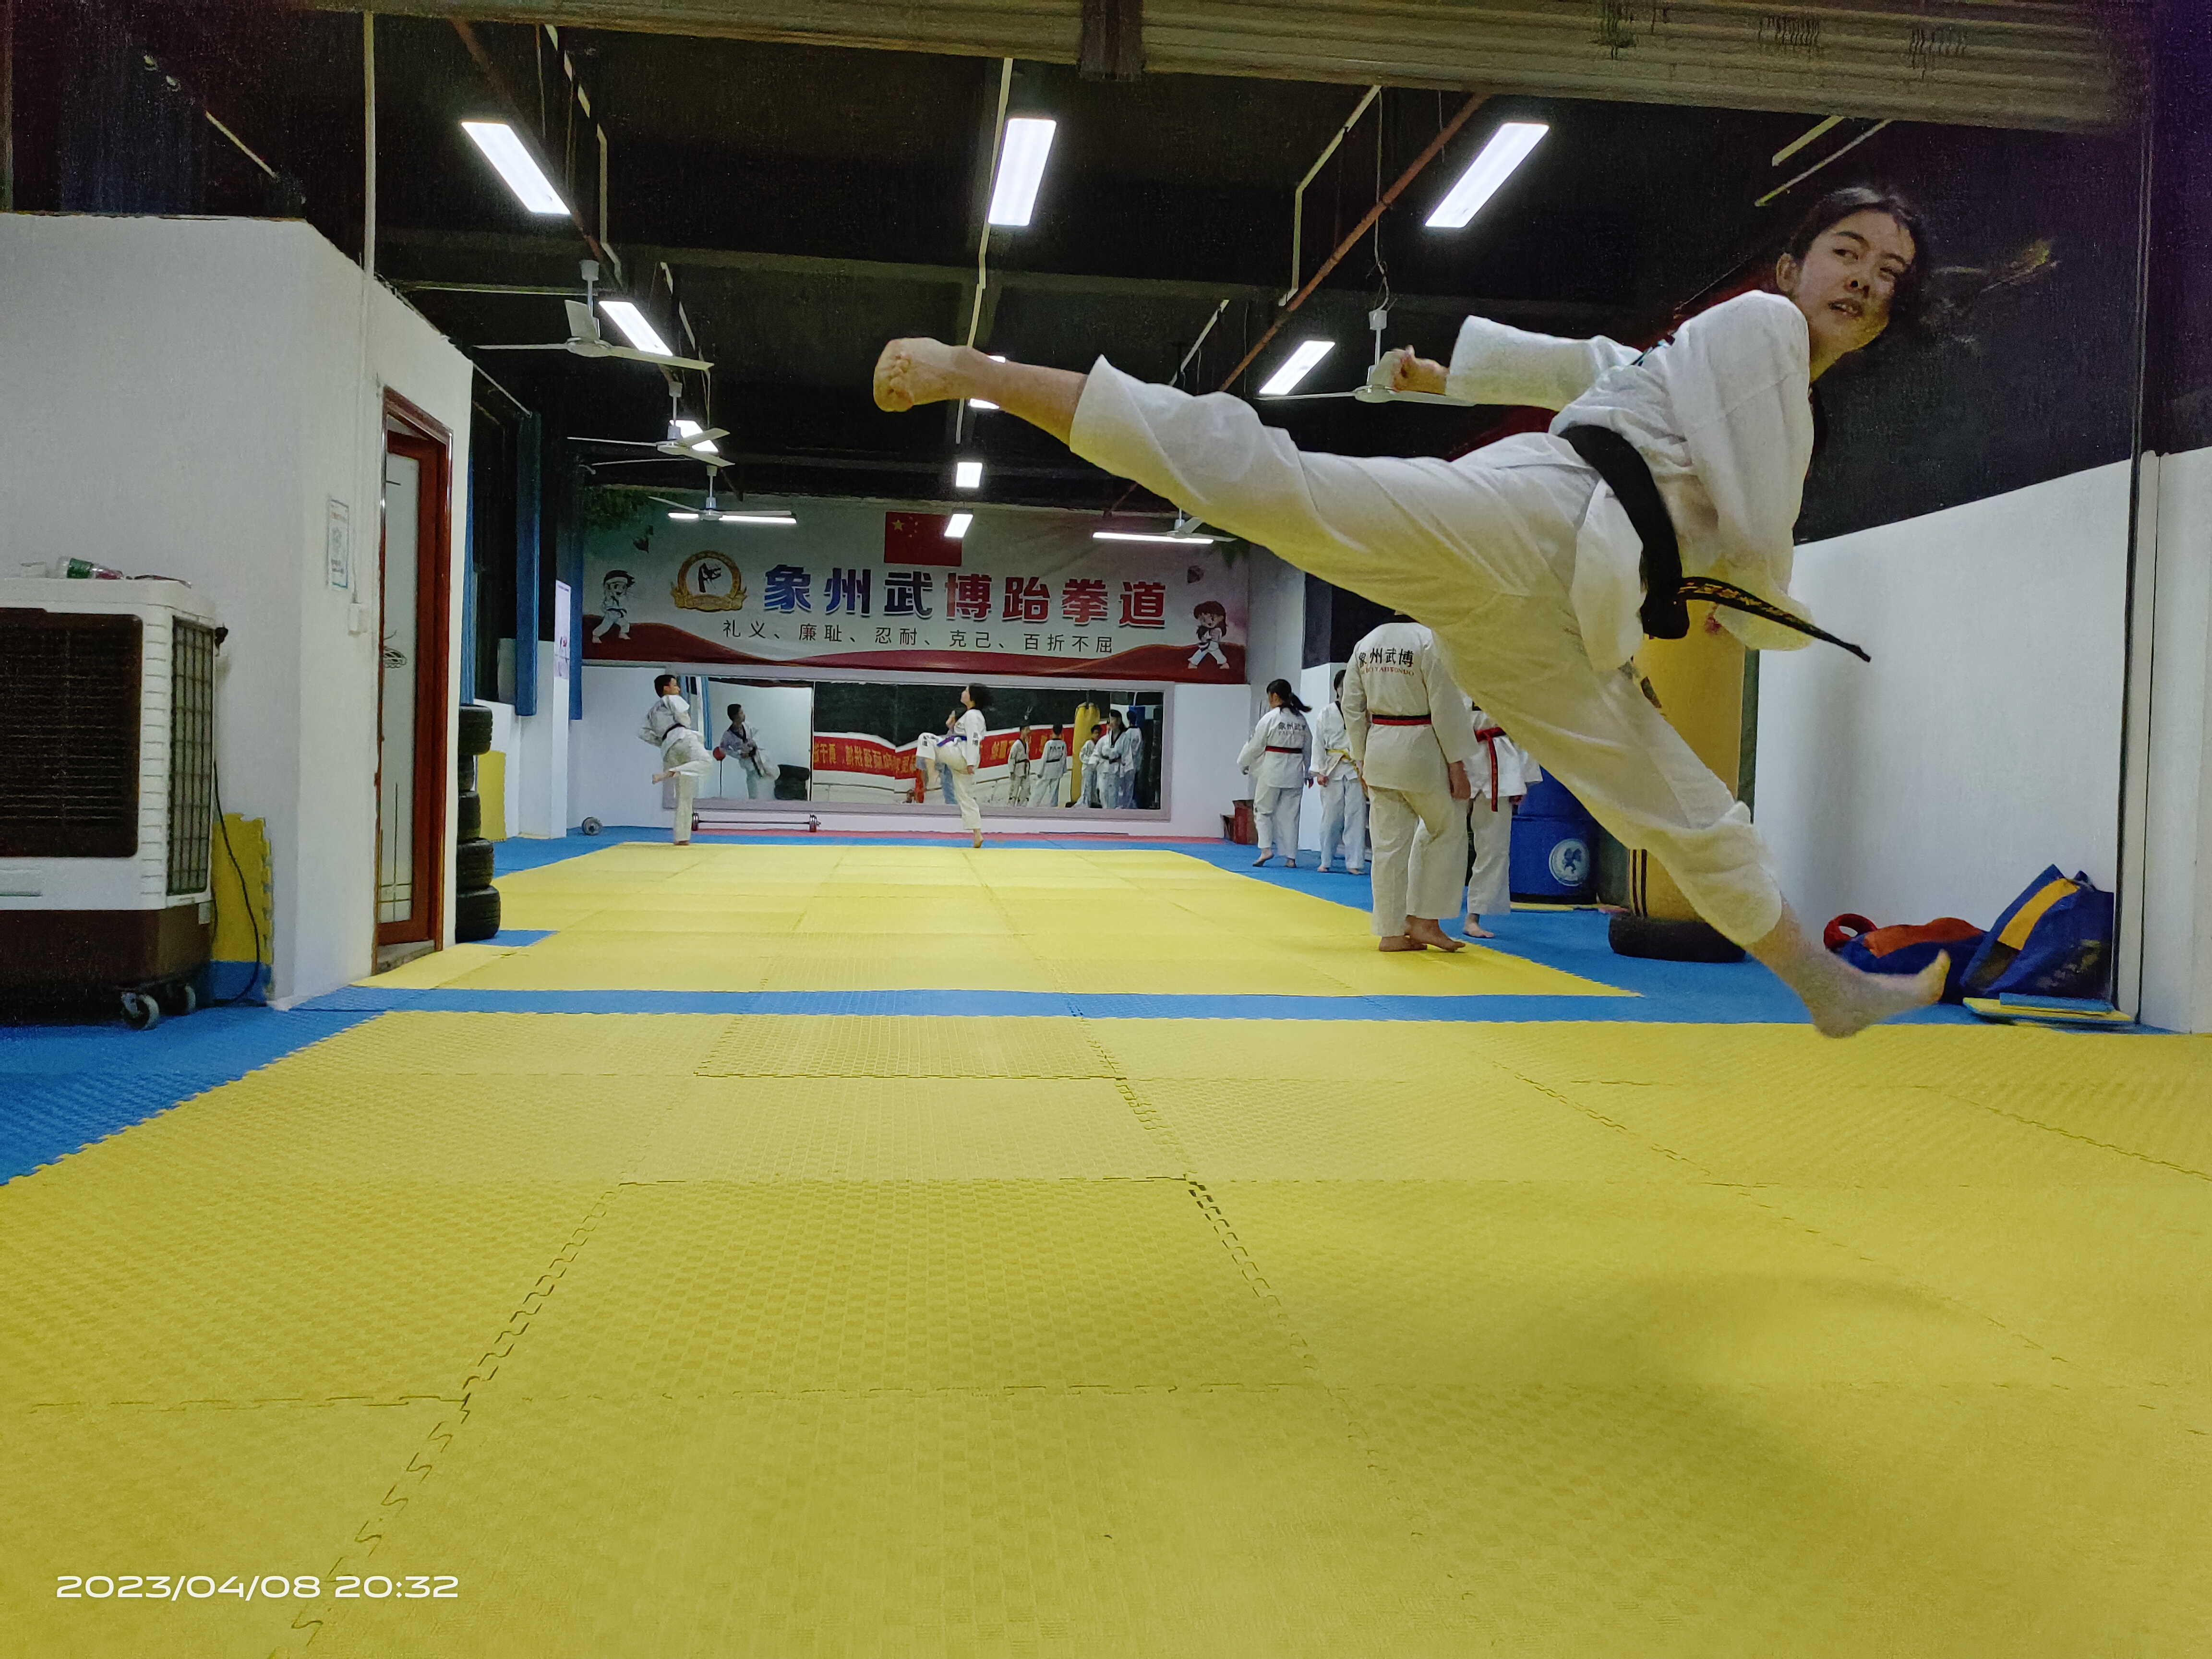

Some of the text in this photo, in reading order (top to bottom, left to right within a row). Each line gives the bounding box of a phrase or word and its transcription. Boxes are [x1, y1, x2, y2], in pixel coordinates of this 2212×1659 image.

[763, 564, 1166, 628] 象州武博跆拳道
[723, 619, 1113, 654] 礼义、廉耻、忍耐、克己、百折不屈
